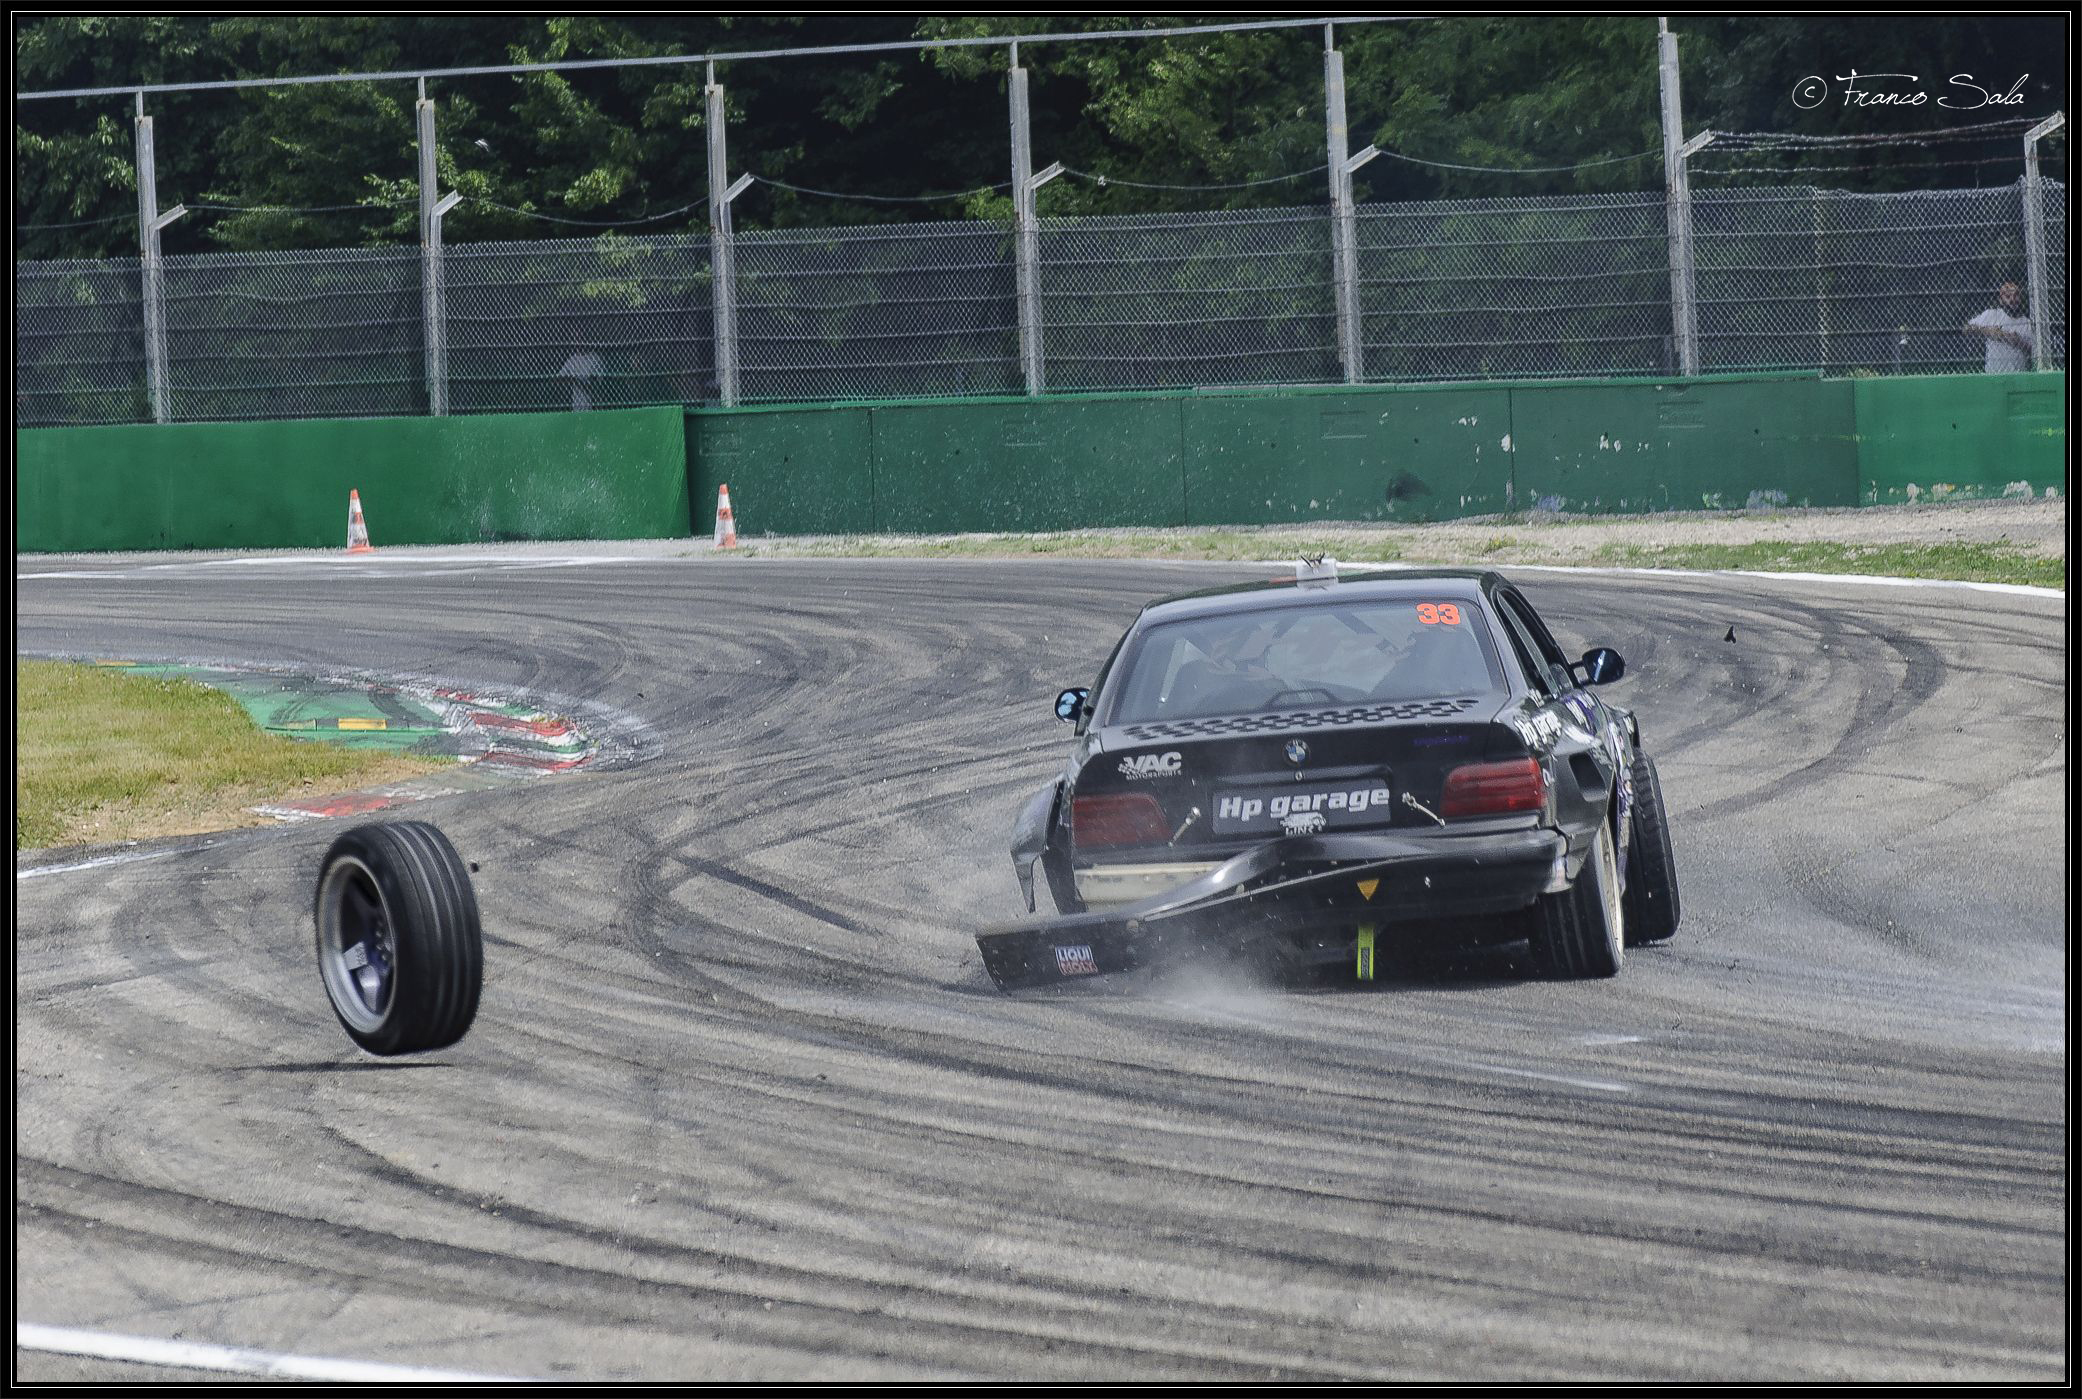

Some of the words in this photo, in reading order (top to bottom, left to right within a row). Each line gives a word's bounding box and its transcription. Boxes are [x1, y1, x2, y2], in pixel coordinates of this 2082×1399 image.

[1416, 603, 1461, 624] 33
[1122, 751, 1182, 773] VAC
[1219, 796, 1263, 822] Hp
[1270, 788, 1390, 818] garage
[1058, 948, 1091, 962] LIQUI
